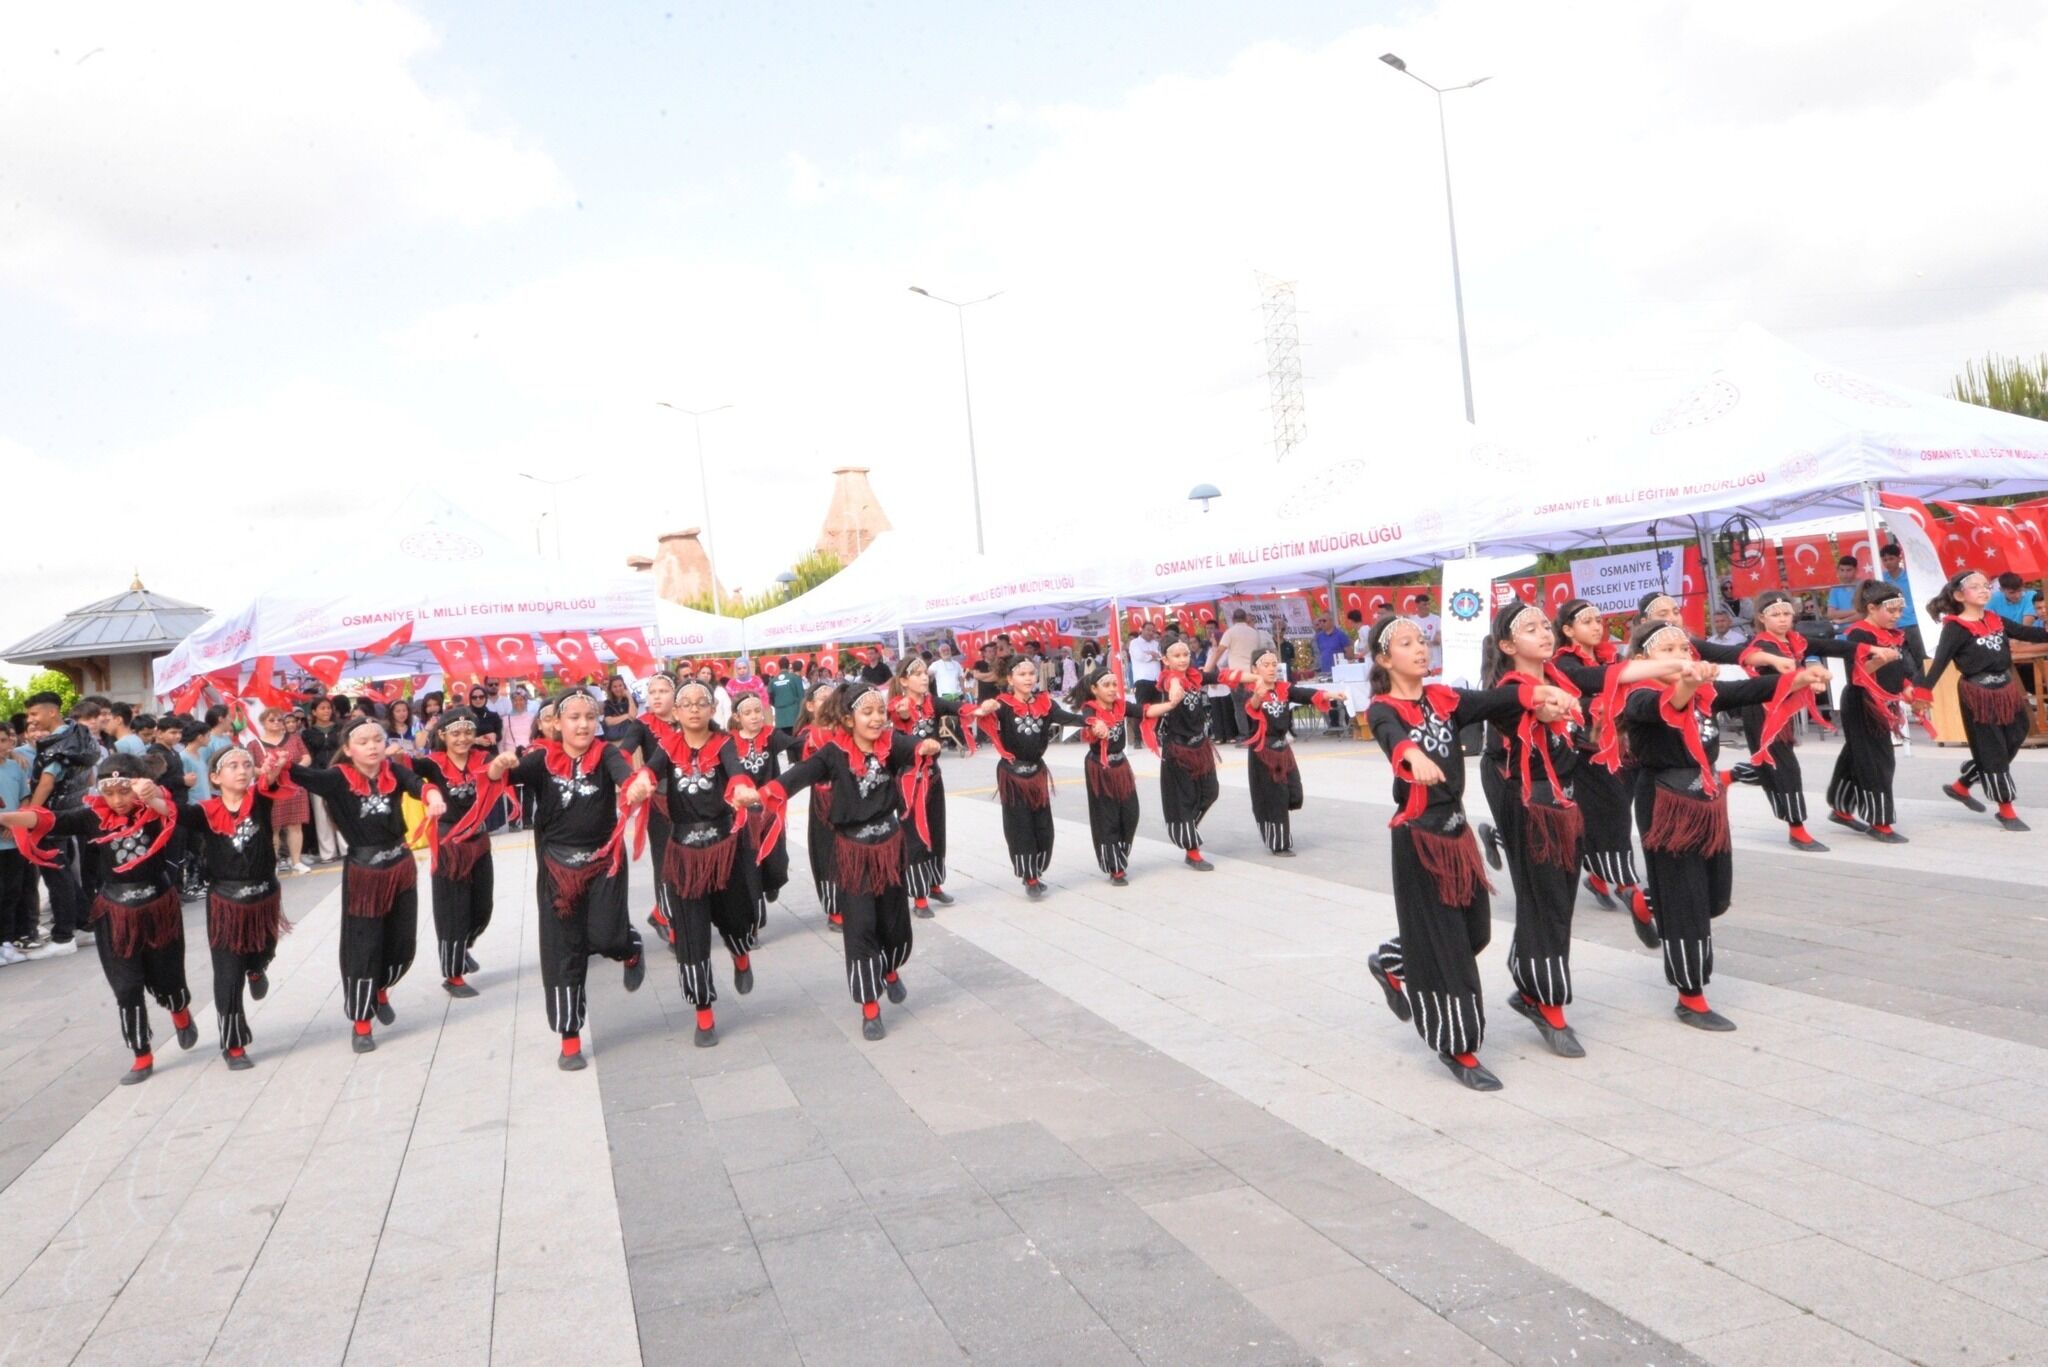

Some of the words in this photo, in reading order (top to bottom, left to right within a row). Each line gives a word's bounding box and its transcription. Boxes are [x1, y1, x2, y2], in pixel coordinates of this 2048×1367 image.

[1155, 555, 1213, 576] OSMANİYE
[1215, 552, 1226, 568] İL
[1229, 547, 1259, 566] MİLLİ
[1262, 540, 1305, 562] EĞİTİM
[1309, 522, 1401, 553] MÜDÜRLÜĞÜ
[1600, 561, 1652, 577] OSMANİYE
[1581, 582, 1621, 597] MESLEKİ
[1623, 581, 1636, 592] VE
[1637, 575, 1670, 590] TEKNK
[1590, 599, 1635, 613] NADOLU
